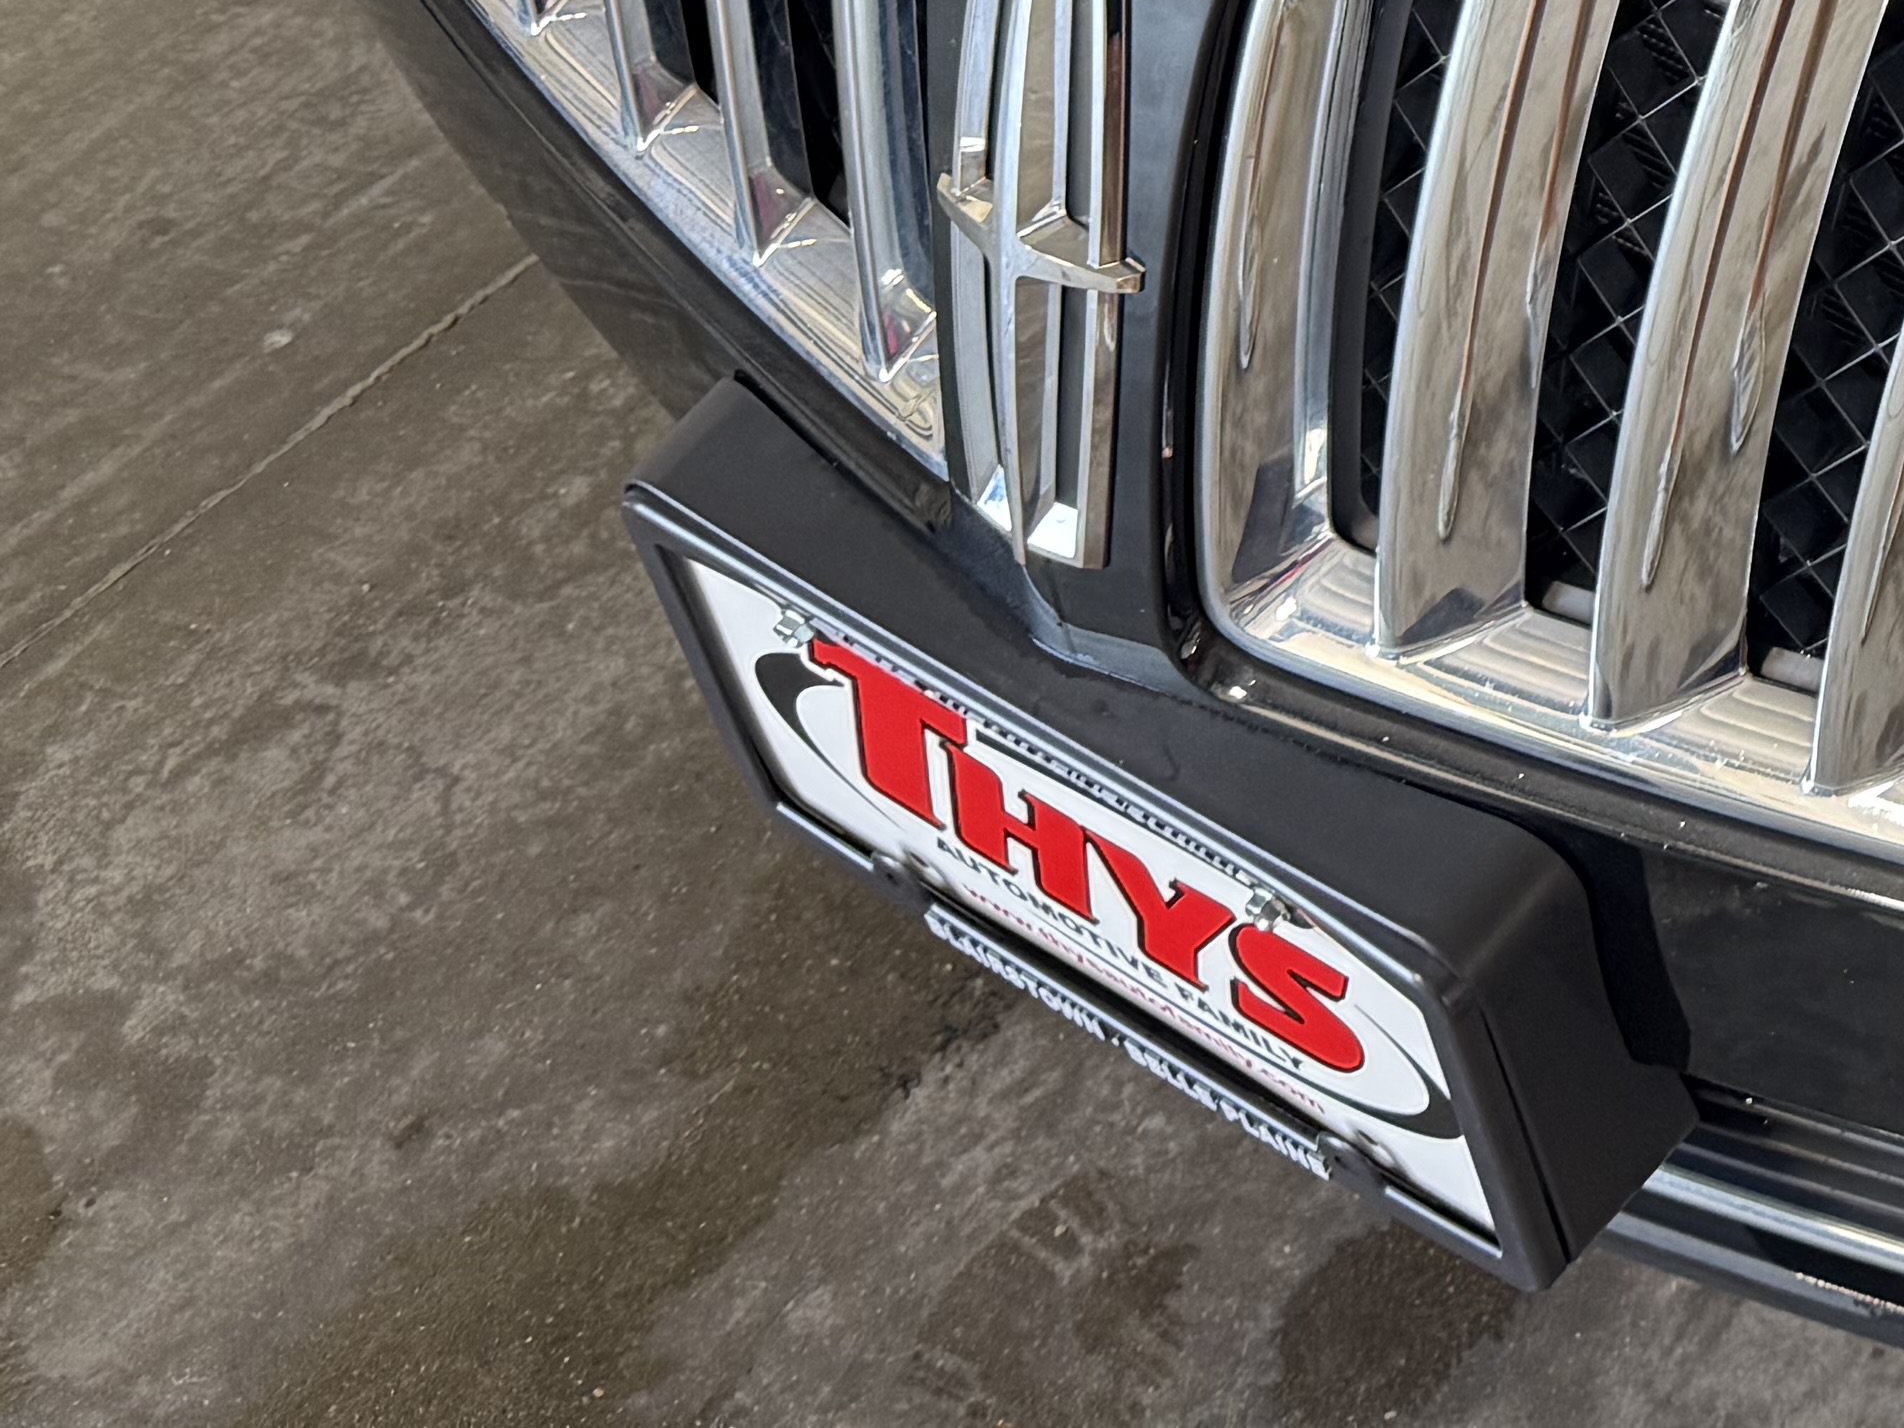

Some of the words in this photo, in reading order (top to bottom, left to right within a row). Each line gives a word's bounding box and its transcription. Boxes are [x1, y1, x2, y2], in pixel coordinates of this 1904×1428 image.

[808, 635, 1366, 1075] THYS
[936, 836, 1166, 988] AUTOMOTIVE
[1175, 981, 1305, 1071] FAMILY
[962, 882, 1326, 1115] www.thysautofamily.com
